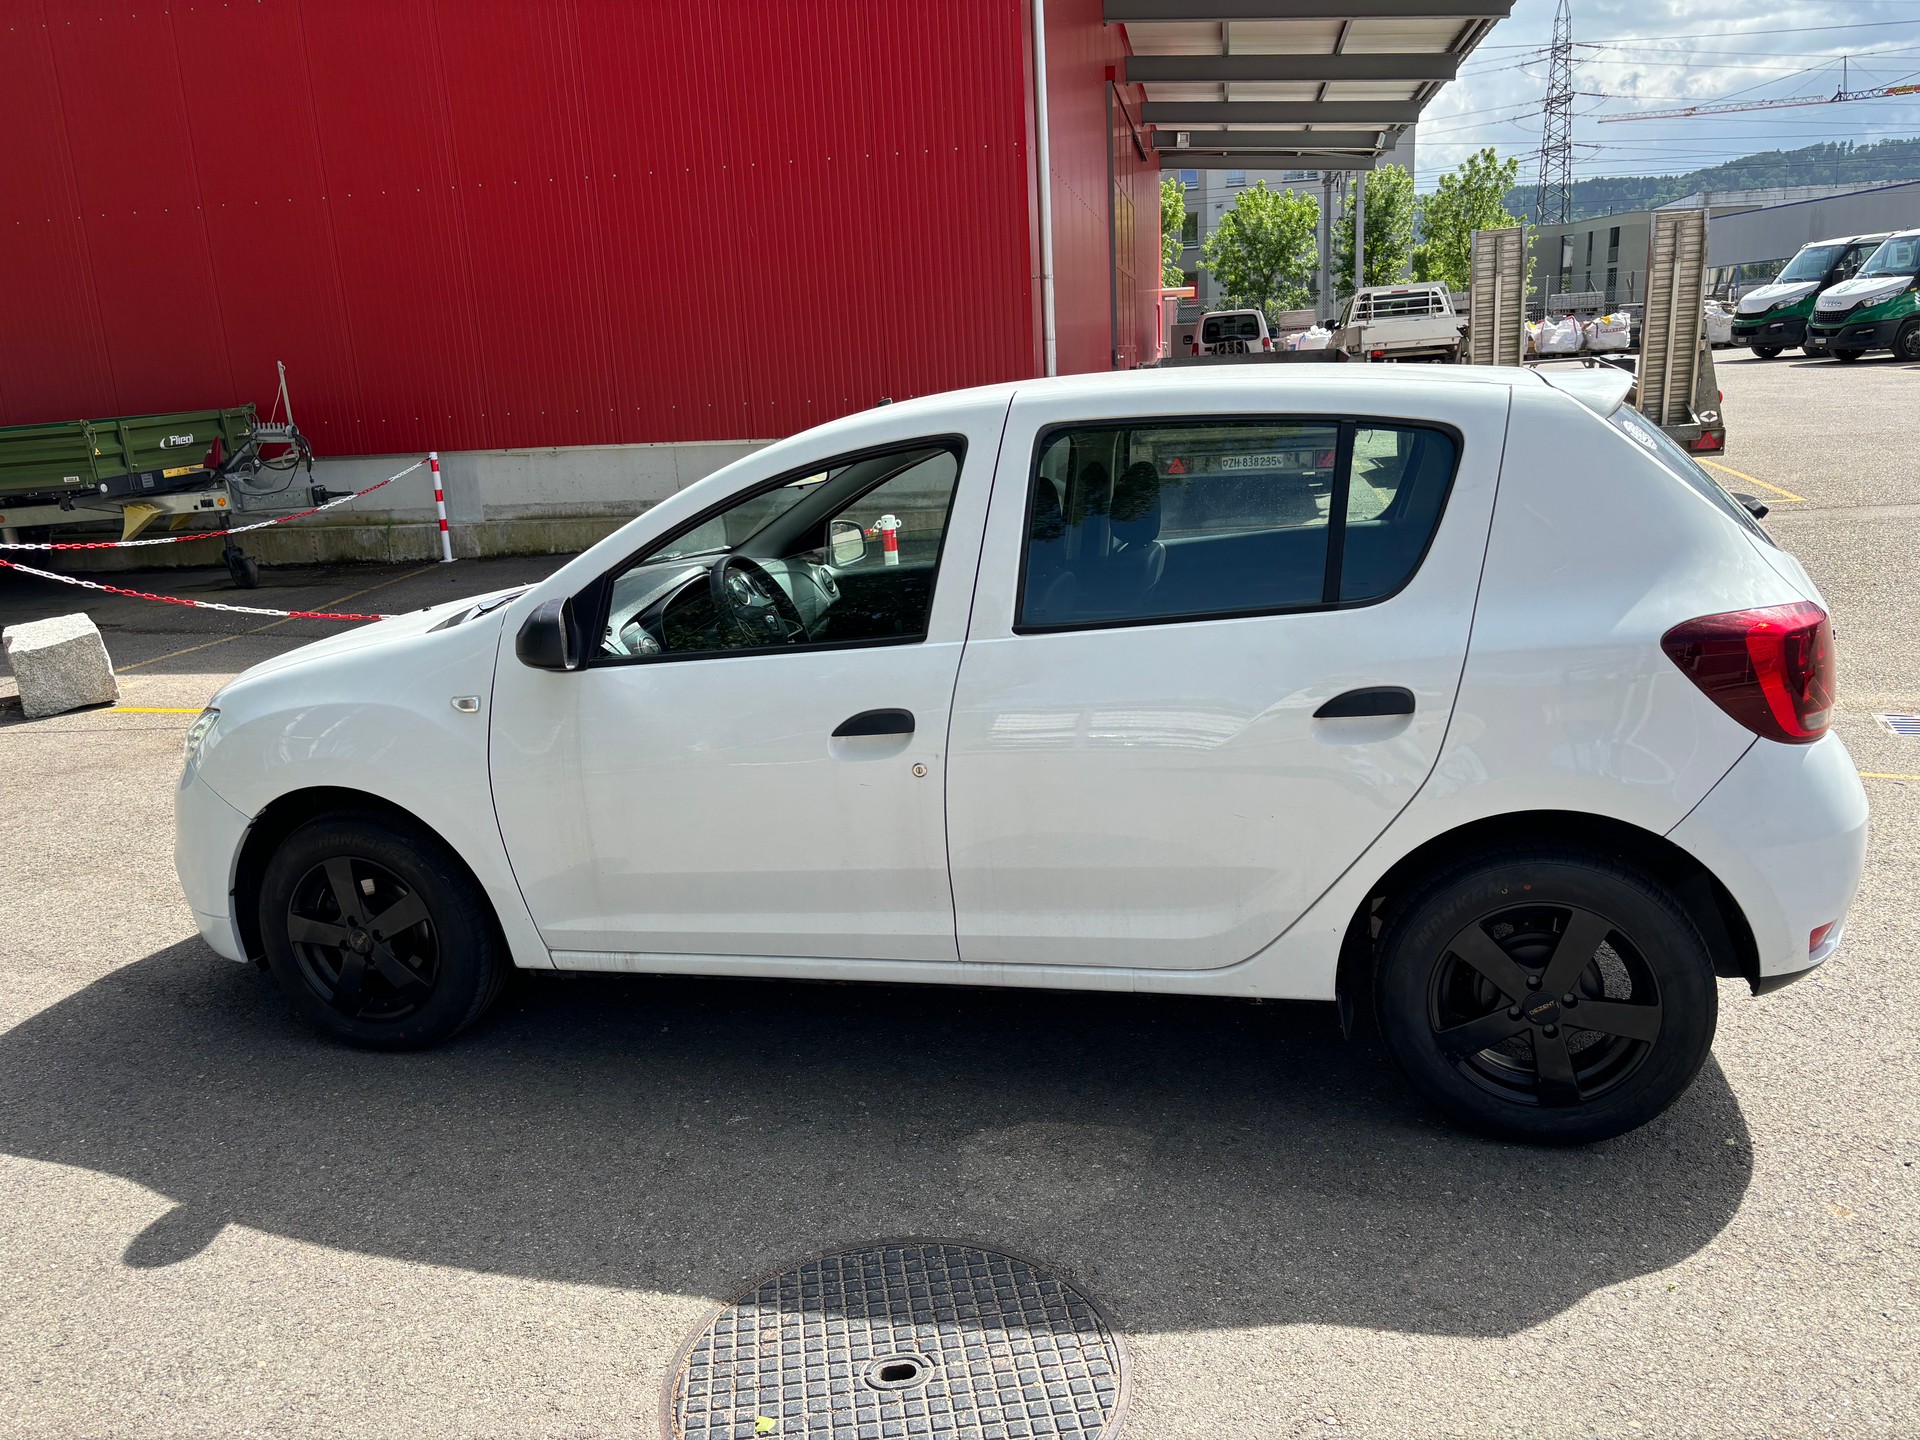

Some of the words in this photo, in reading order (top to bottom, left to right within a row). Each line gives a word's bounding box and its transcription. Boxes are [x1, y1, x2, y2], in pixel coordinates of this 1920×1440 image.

[1822, 300, 1842, 308] IVECO
[169, 433, 194, 446] Fliegl
[1528, 999, 1556, 1015] DEZENT
